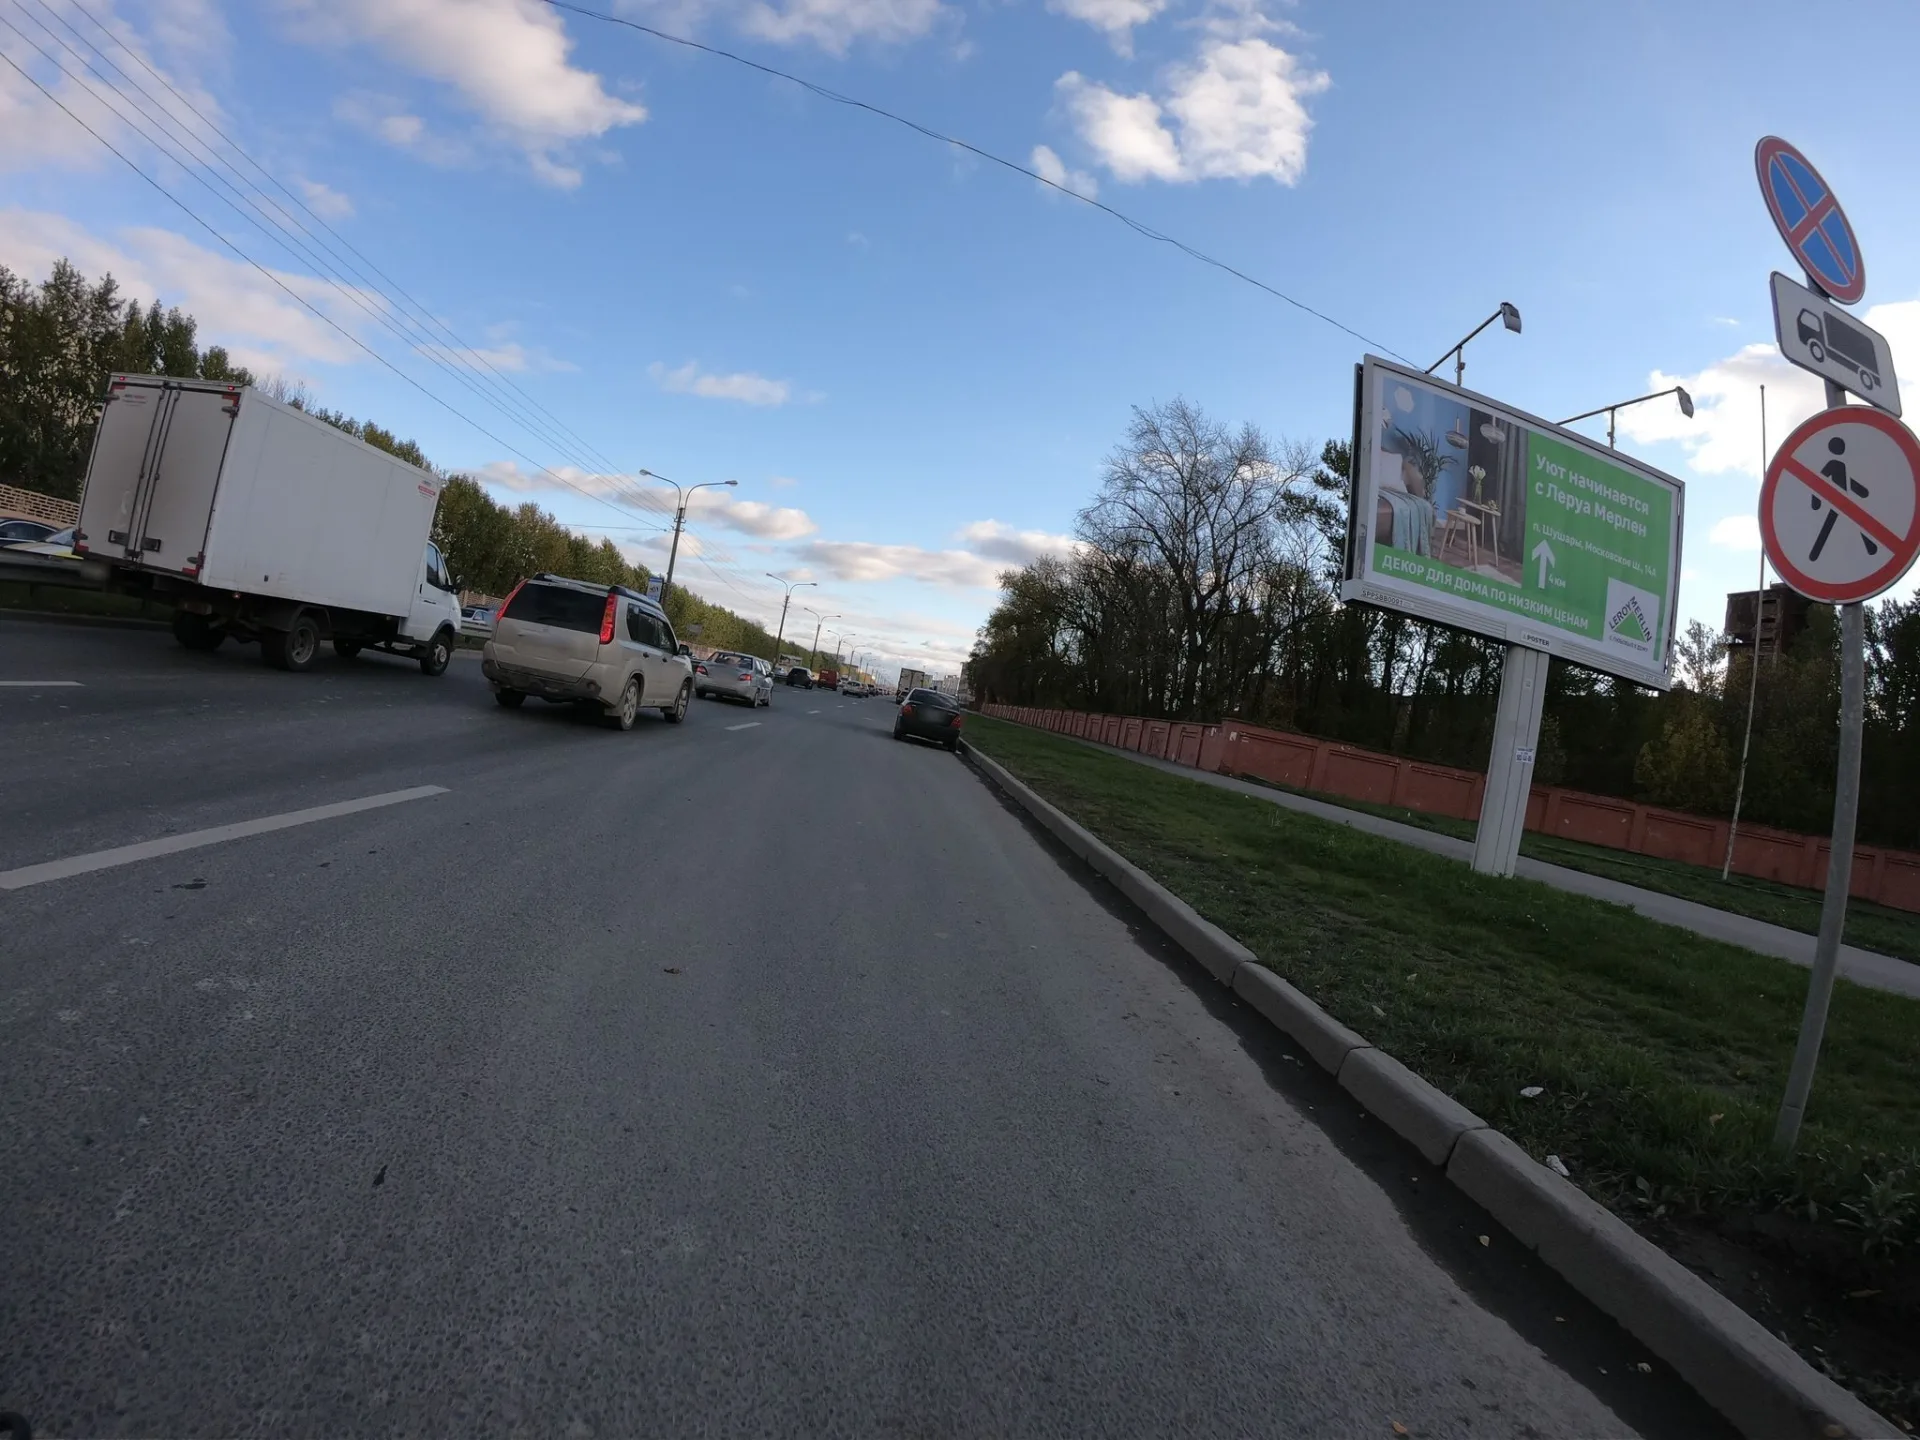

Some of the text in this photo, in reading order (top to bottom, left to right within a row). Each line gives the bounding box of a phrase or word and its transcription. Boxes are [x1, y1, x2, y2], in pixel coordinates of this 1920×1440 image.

[1536, 454, 1649, 515] Уют начинается
[1535, 482, 1647, 537] с Леруа Мерлен
[1542, 524, 1583, 549] Шушары,
[1585, 541, 1631, 567] Московское
[1381, 554, 1589, 631] ДЕКОР ДЛЯ ДОМА ПО НИЗКИМ ЦЕНАМ
[1548, 573, 1554, 584] 4
[1526, 634, 1551, 648] POSTER
[1608, 595, 1653, 643] LEROY MERLIN
